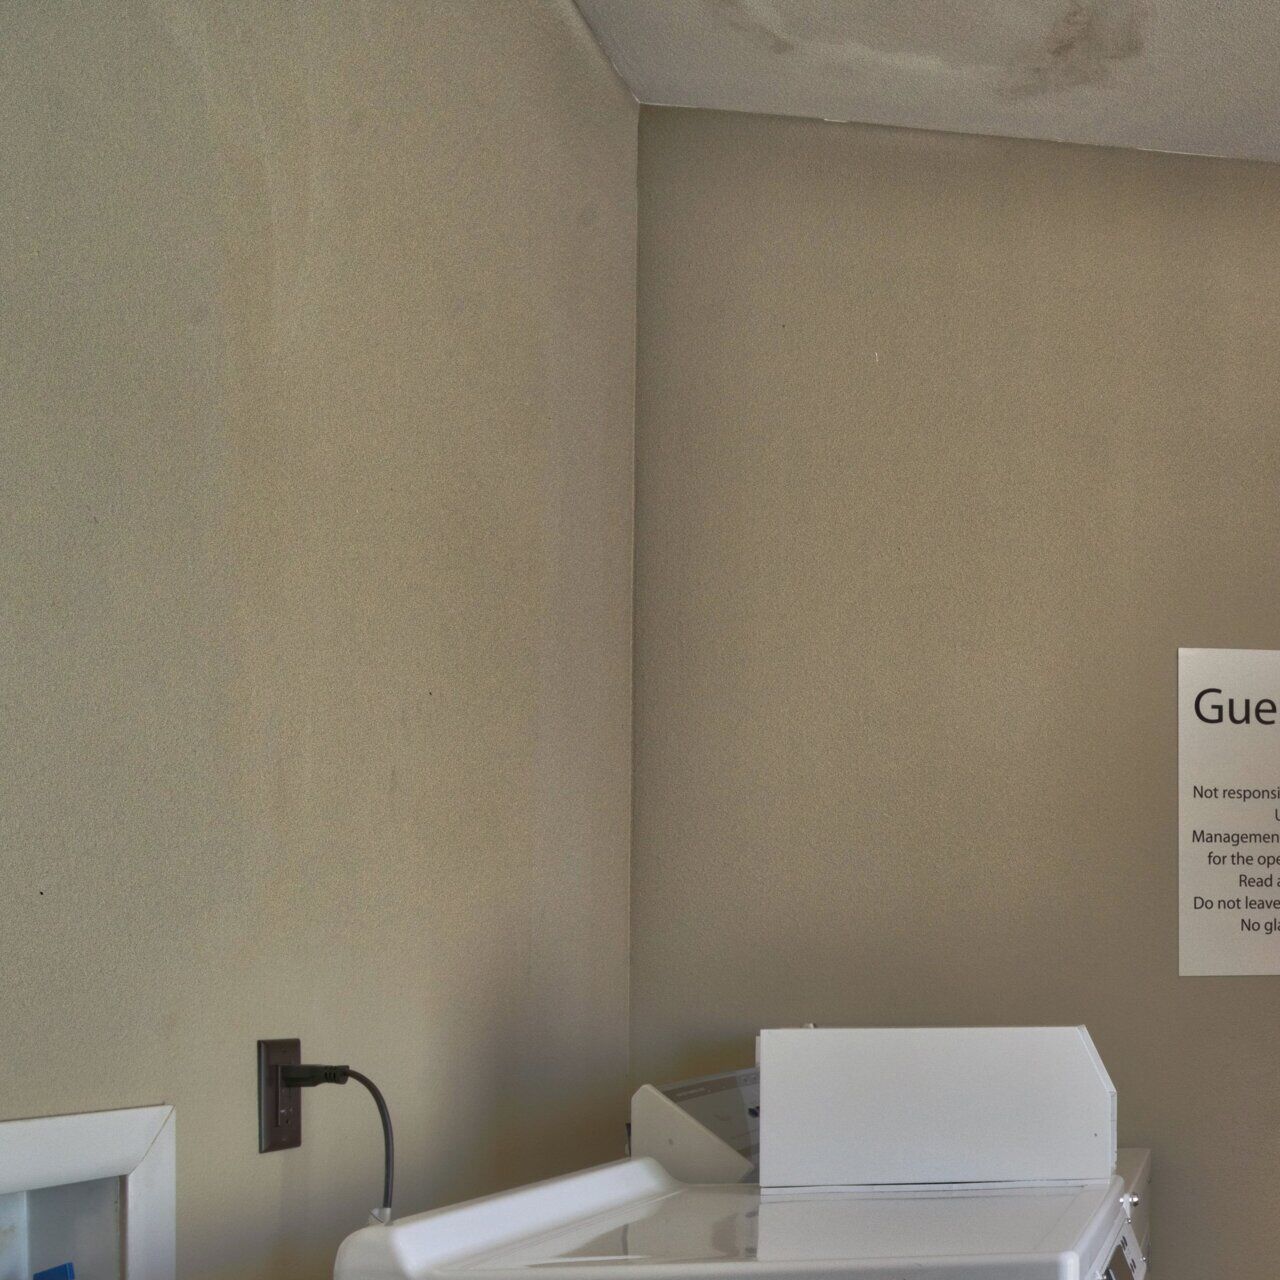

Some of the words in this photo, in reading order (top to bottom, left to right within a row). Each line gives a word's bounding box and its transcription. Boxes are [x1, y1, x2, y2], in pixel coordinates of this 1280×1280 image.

[1193, 785, 1219, 799] Not
[1207, 851, 1227, 865] for
[1231, 852, 1253, 865] the
[1239, 874, 1273, 887] Read
[1194, 896, 1213, 910] Do
[1218, 898, 1241, 909] not
[1245, 896, 1280, 909] leave
[1241, 918, 1260, 931] No
